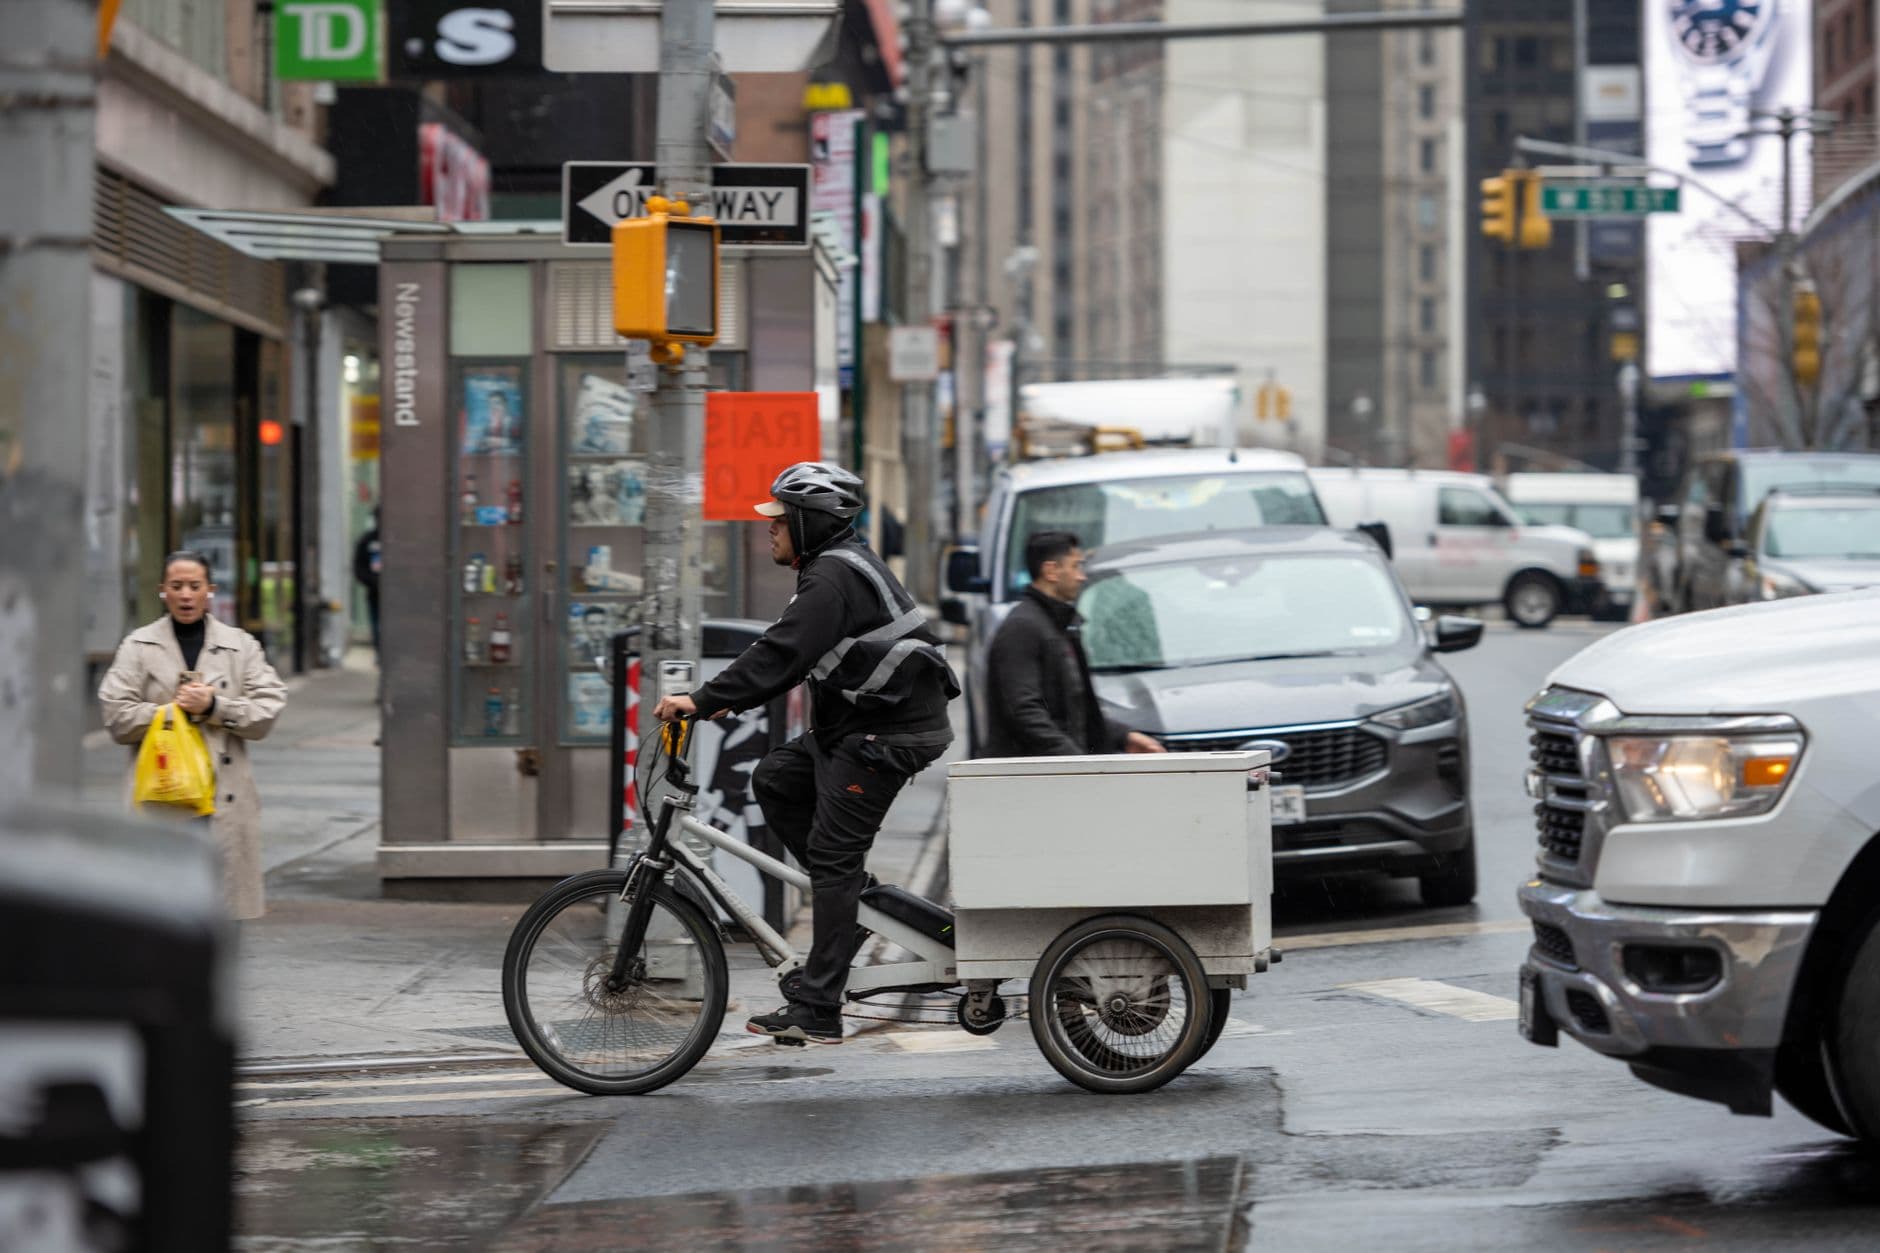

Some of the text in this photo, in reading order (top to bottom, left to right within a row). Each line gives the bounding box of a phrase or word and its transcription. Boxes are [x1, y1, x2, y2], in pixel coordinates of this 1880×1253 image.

[283, 3, 366, 60] TD
[713, 190, 783, 221] WAY
[395, 283, 420, 426] Newsstand
